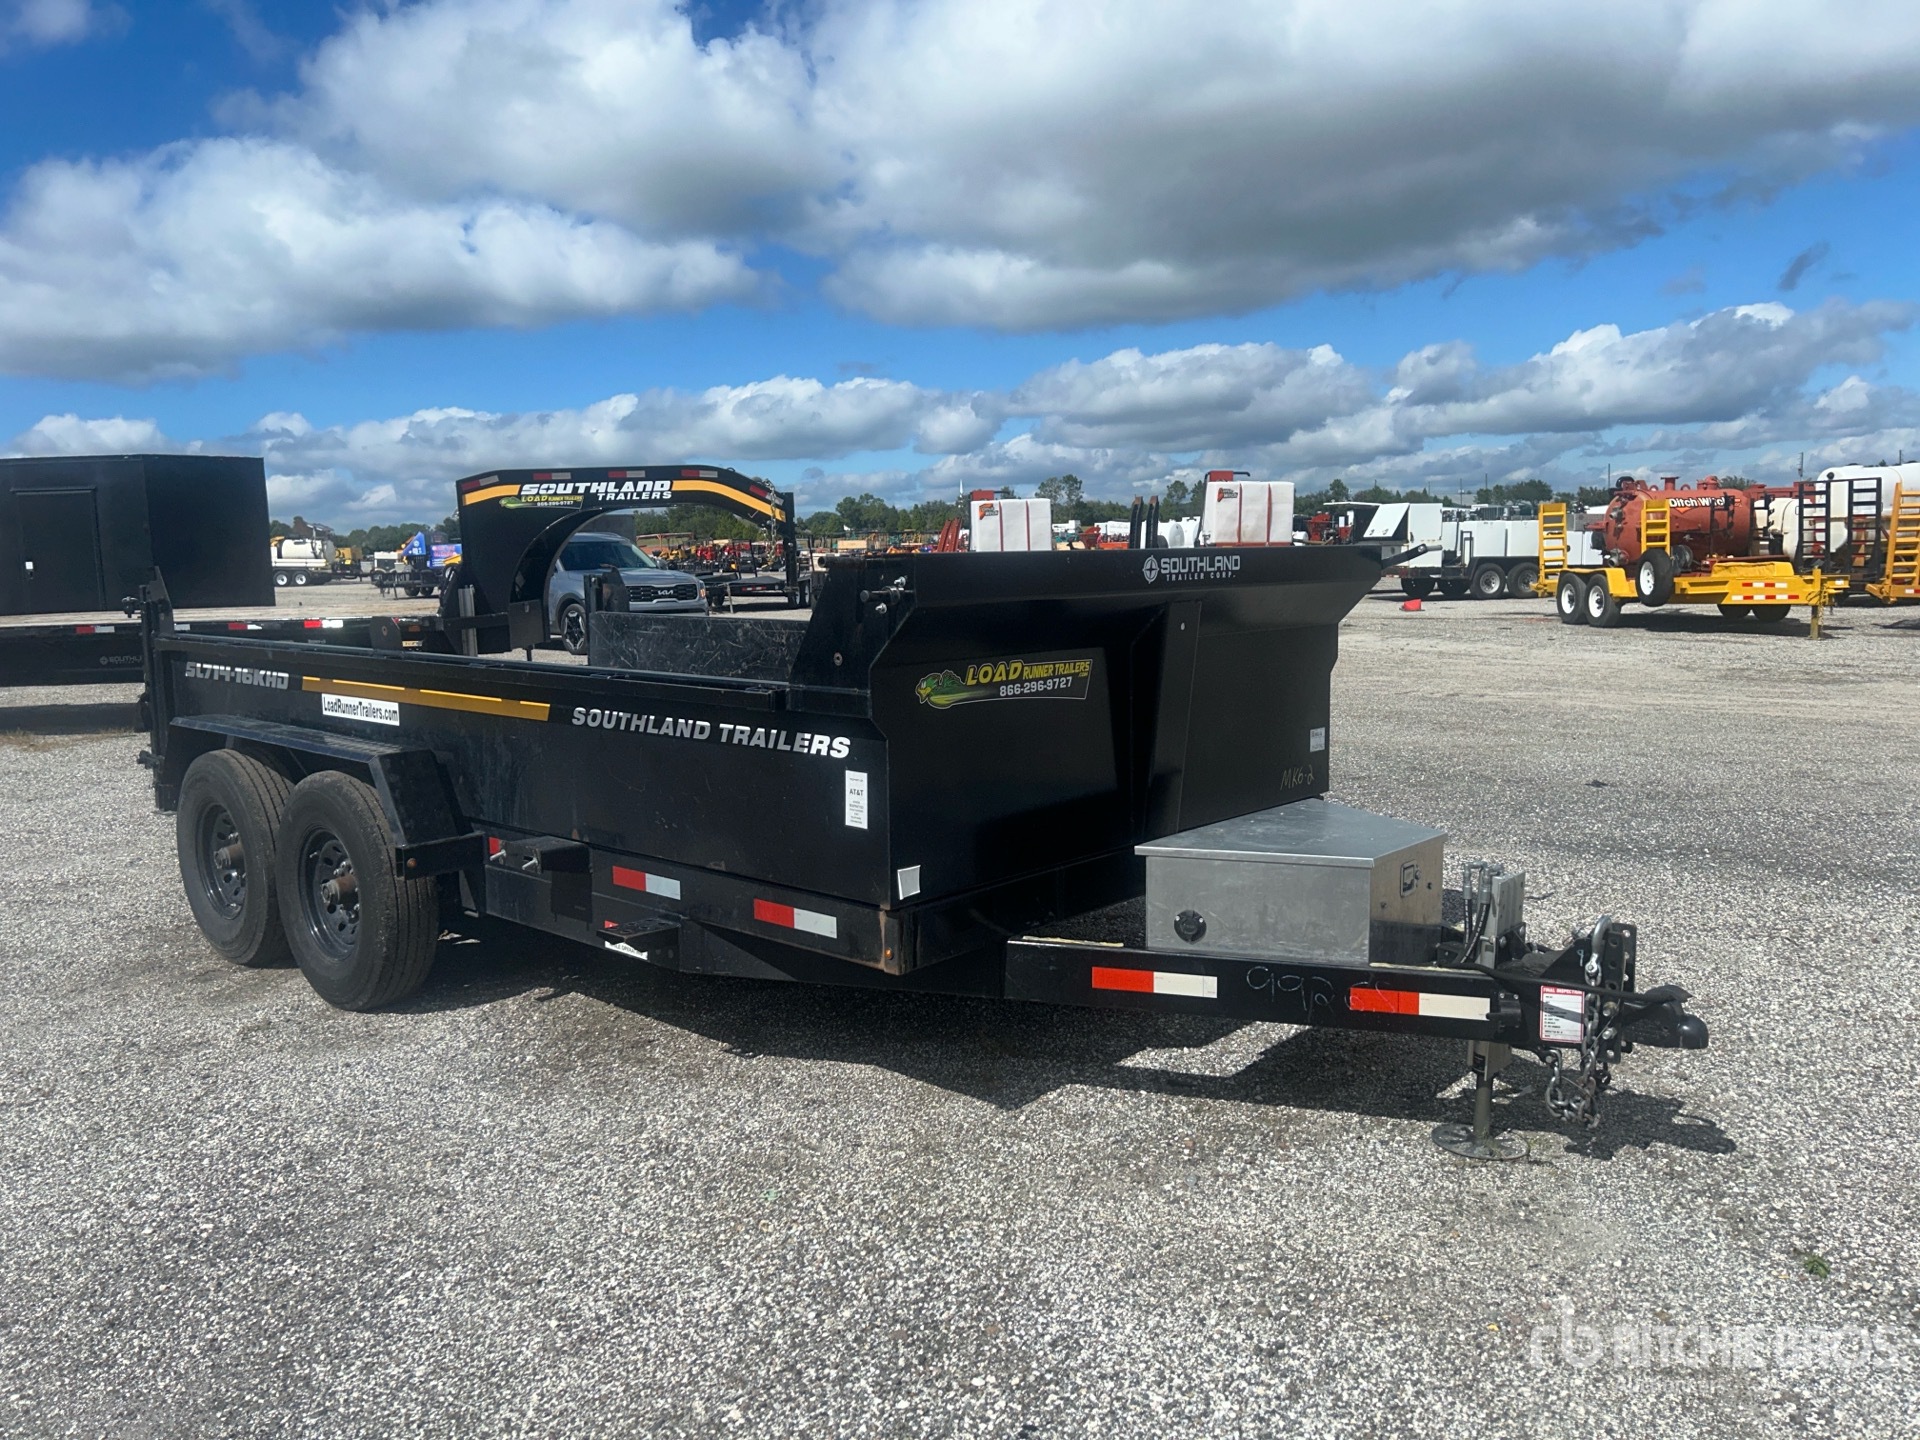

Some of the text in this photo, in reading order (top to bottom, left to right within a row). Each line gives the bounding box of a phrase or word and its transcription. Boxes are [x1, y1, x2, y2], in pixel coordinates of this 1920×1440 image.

[520, 480, 672, 495] SOUTHLAND
[597, 491, 672, 500] TRAILERS
[1669, 497, 1698, 507] Ditch
[1160, 555, 1241, 574] SOUTHLAND
[1166, 571, 1236, 581] TRAILER CORP.
[185, 661, 290, 690] SL714-16KHD
[966, 661, 1091, 686] LOAD RUNNER TRAILERS
[1000, 676, 1073, 697] 866-296-9727
[323, 697, 399, 722] LoadRunnerTrailers.com
[571, 706, 851, 759] SOUTHLAND TRAILERS
